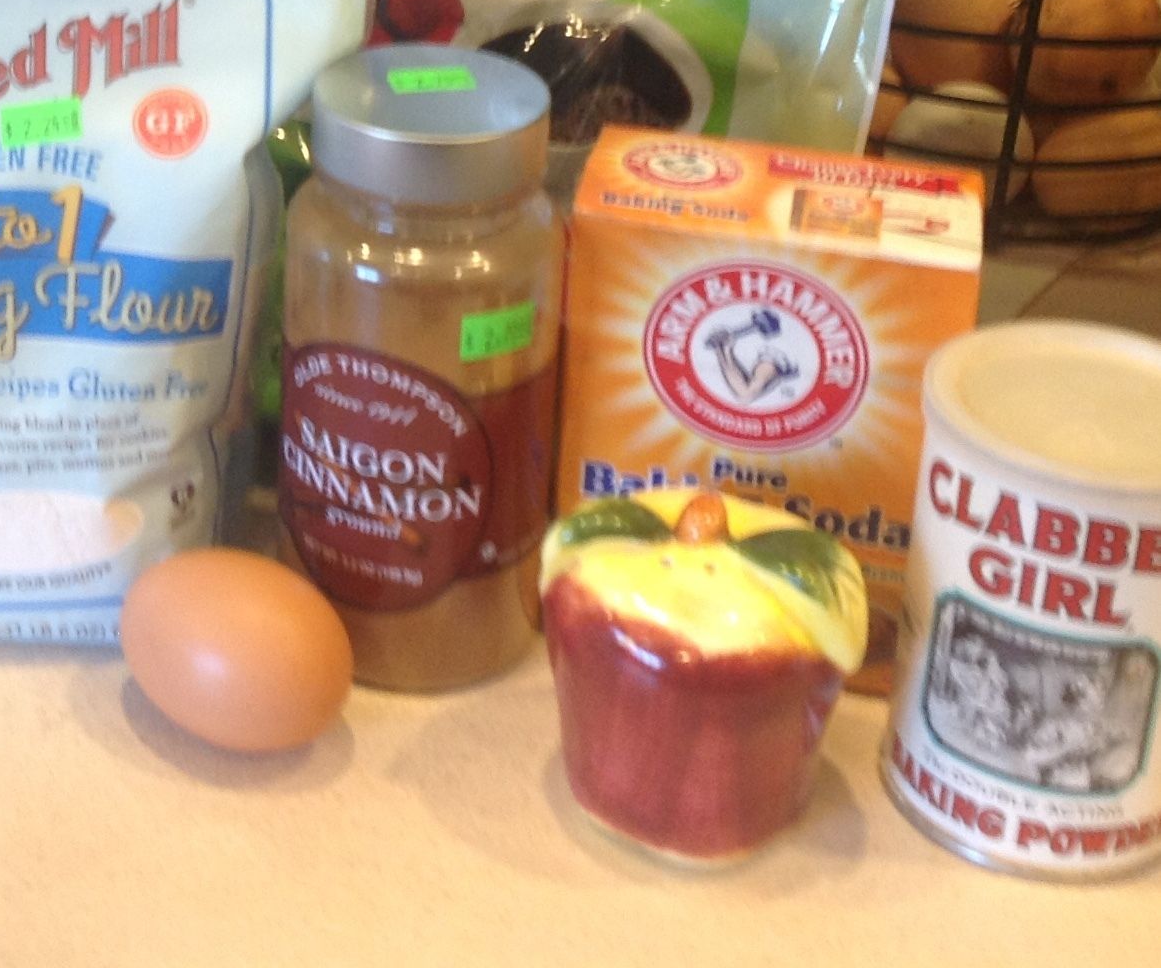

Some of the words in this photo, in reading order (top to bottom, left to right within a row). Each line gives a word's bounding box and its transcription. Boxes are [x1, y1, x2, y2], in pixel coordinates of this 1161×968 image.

[38, 144, 103, 181] FREE
[50, 184, 84, 264] 1
[37, 261, 218, 331] Flour
[657, 286, 707, 365] ARM
[740, 270, 856, 389] HAMMER
[68, 367, 157, 401] Gluten
[336, 353, 467, 438] THOMPSON
[283, 433, 482, 522] CINNAMON
[300, 415, 449, 485] SAIGON
[712, 457, 788, 488] Pure
[969, 544, 1128, 625] GIRL
